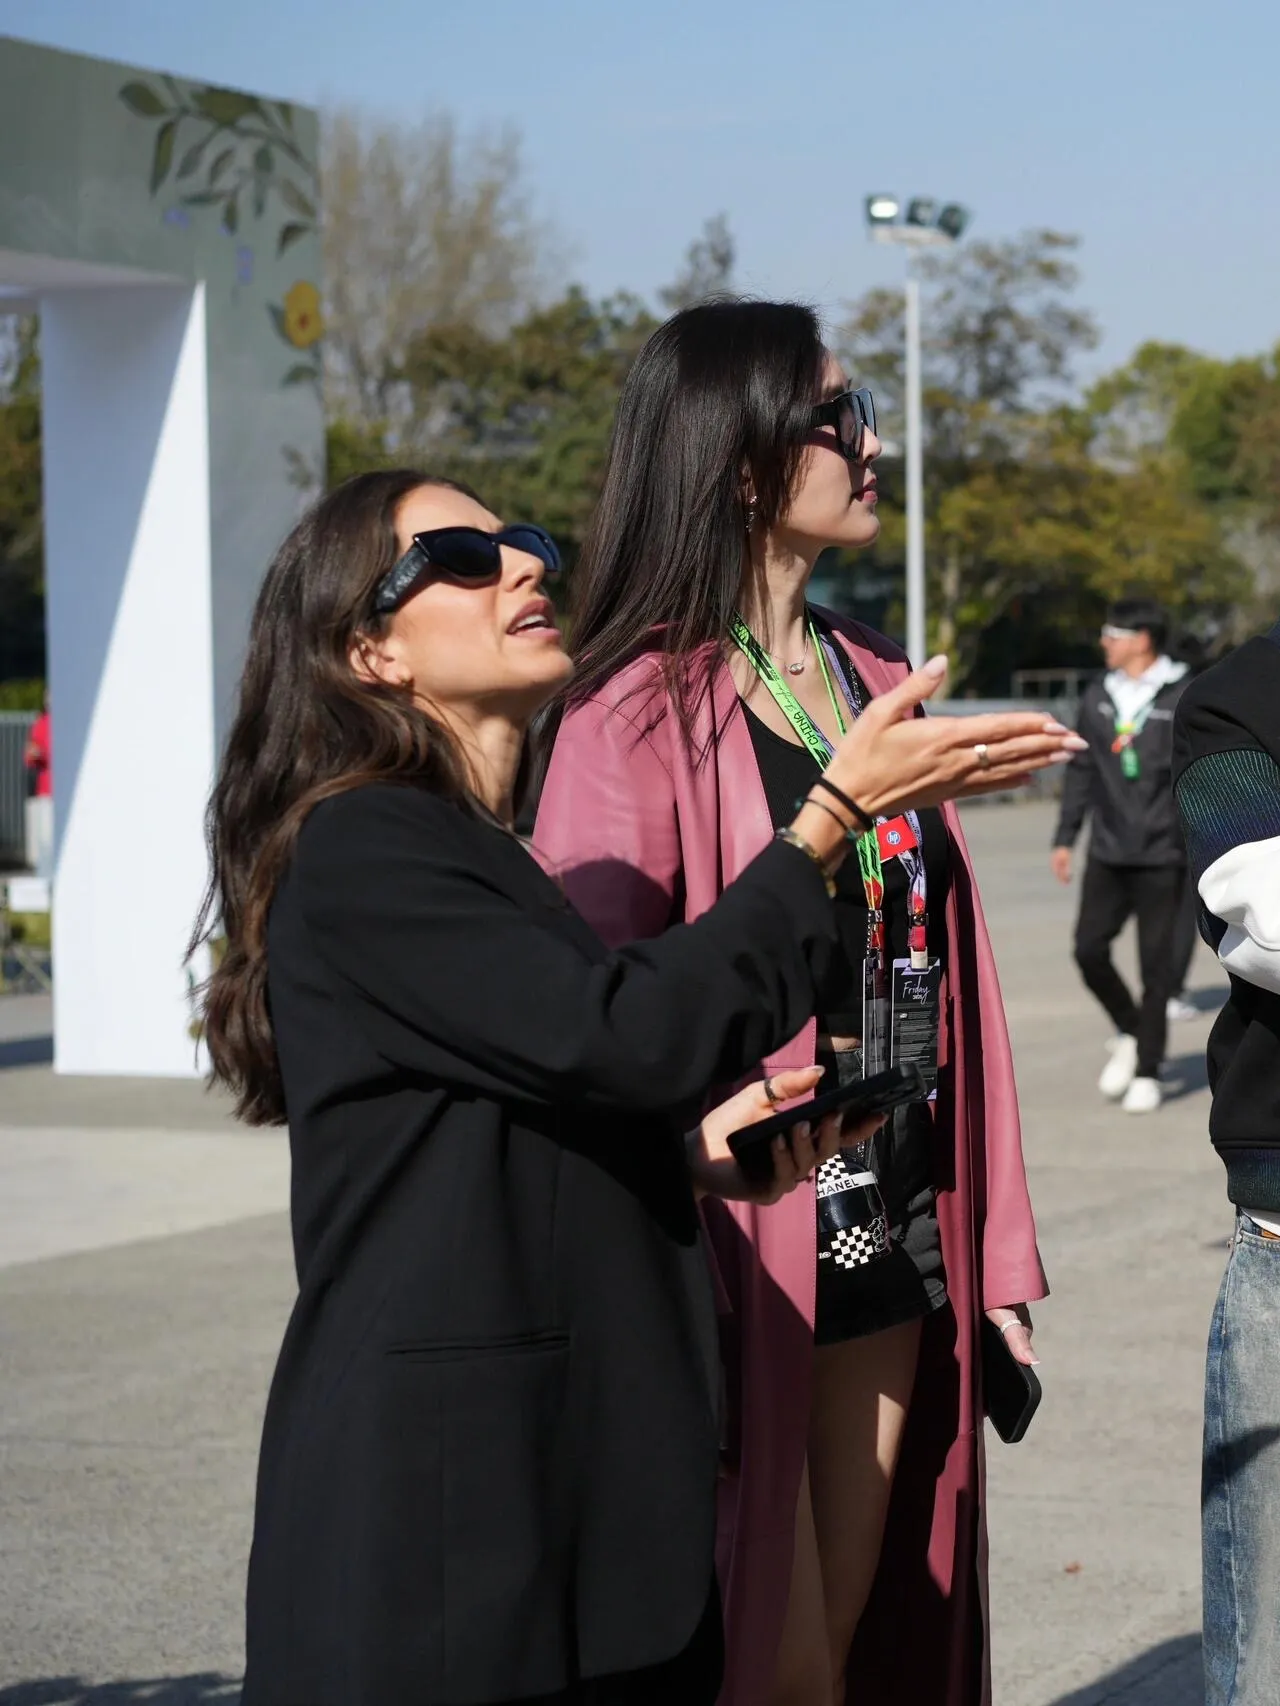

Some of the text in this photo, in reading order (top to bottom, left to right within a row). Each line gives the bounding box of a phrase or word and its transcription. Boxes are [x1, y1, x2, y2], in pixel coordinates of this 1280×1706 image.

[793, 711, 820, 746] CHINA
[902, 974, 931, 1005] Friday
[815, 1178, 859, 1197] HANEL
